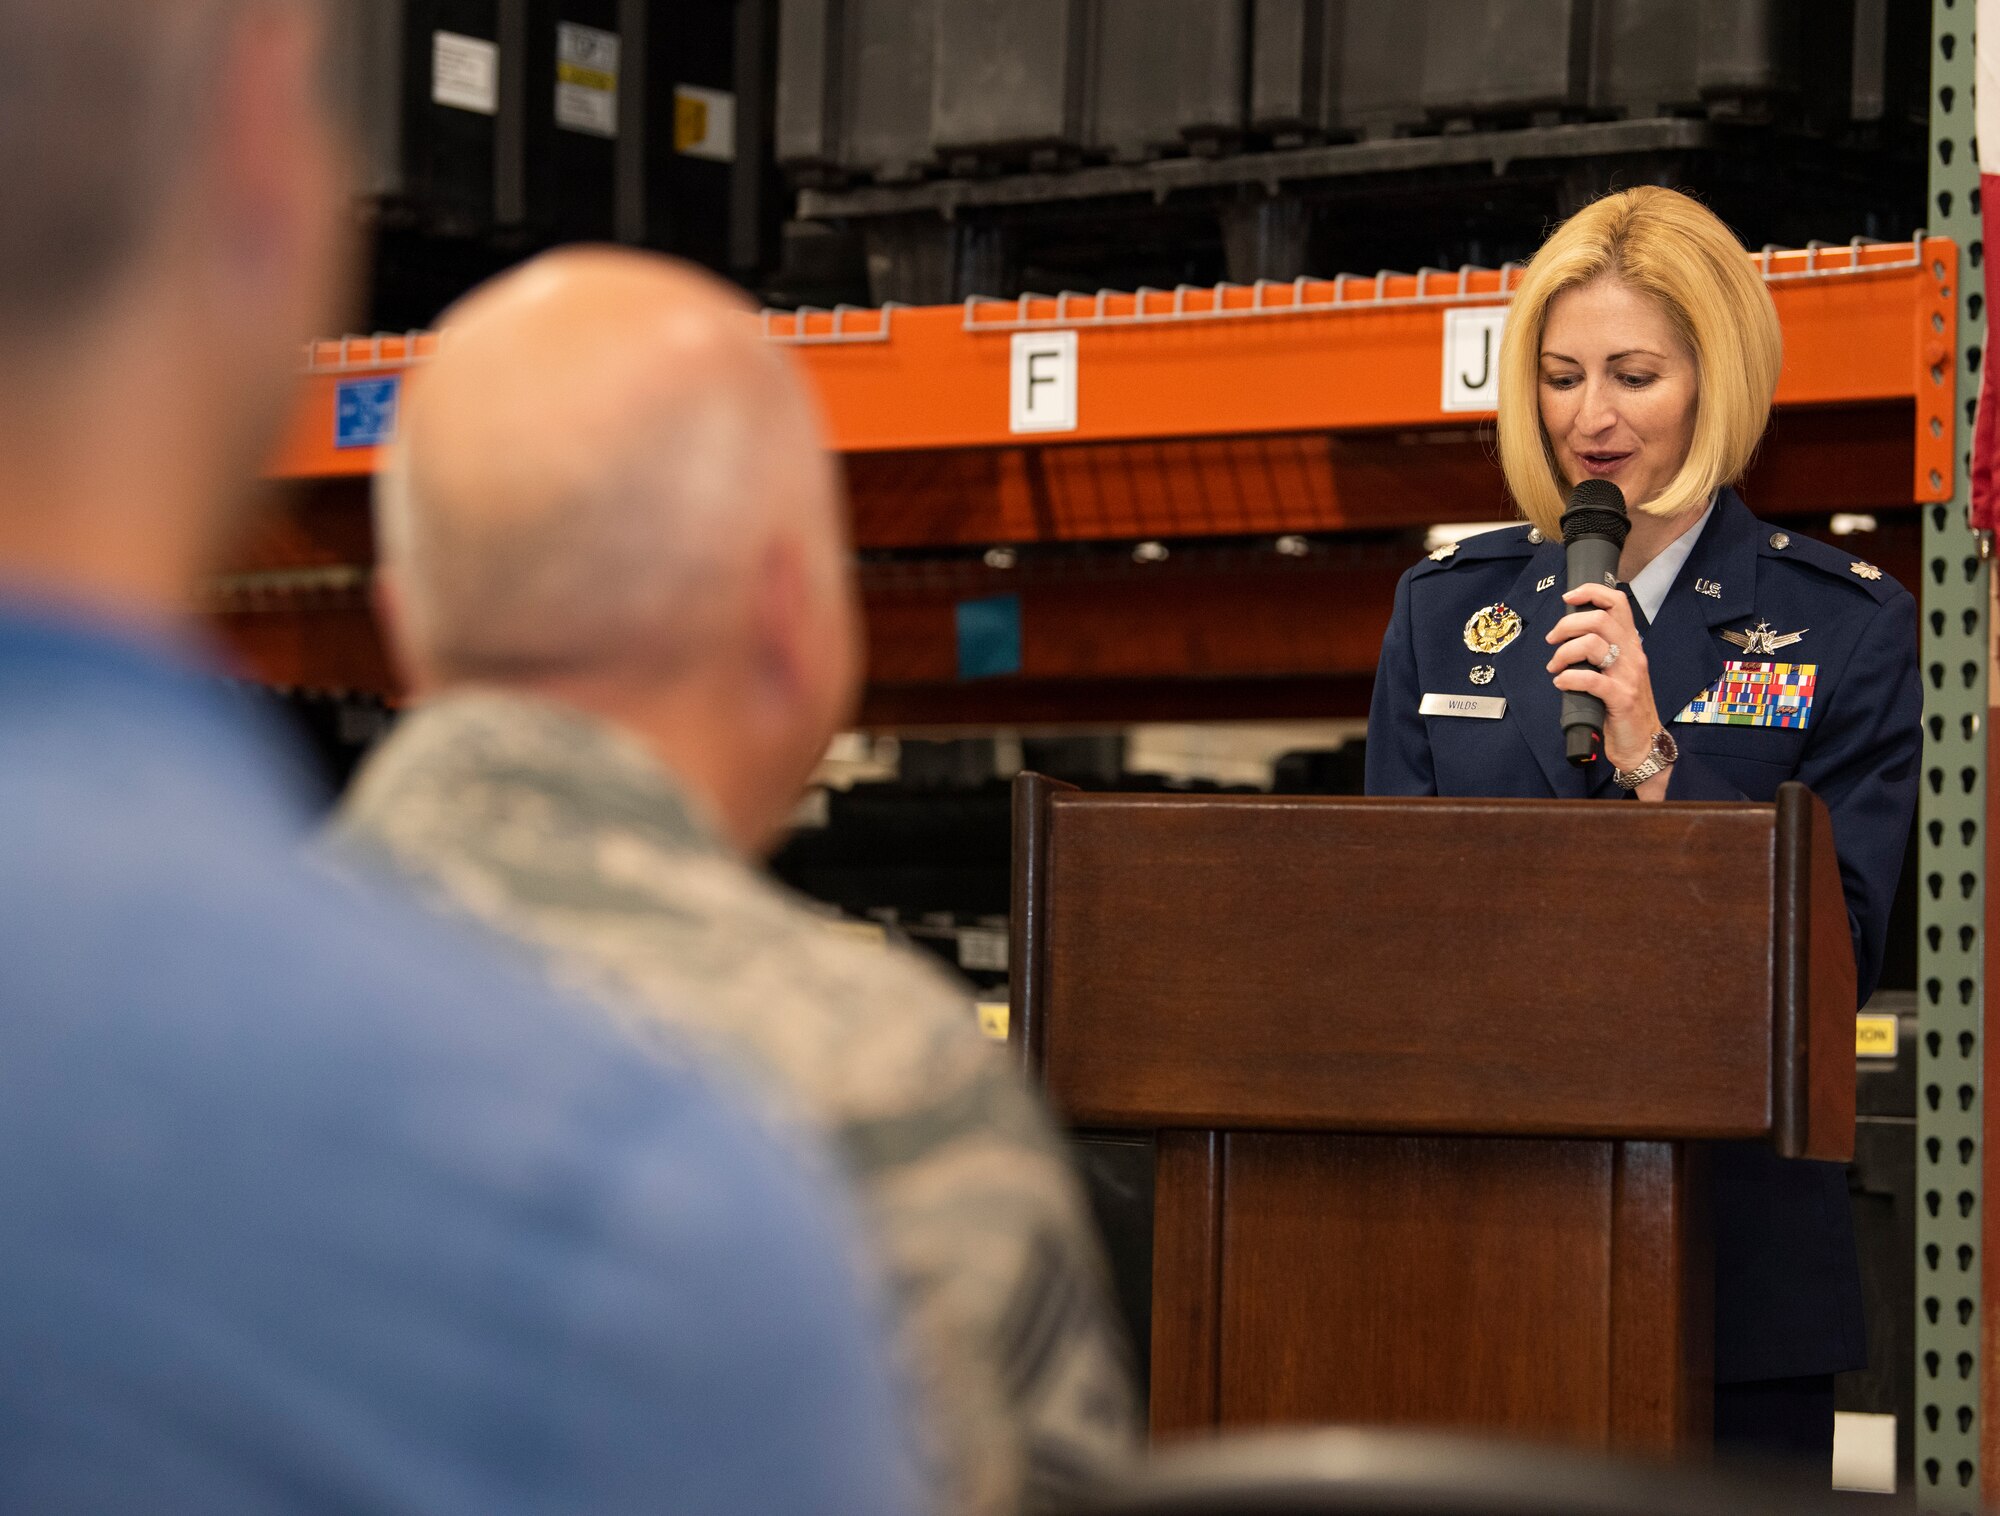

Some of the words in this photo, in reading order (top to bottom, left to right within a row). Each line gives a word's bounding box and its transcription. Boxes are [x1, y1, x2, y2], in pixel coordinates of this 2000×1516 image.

[1028, 351, 1060, 410] F
[1462, 327, 1491, 390] J
[1448, 700, 1478, 710] WILDS
